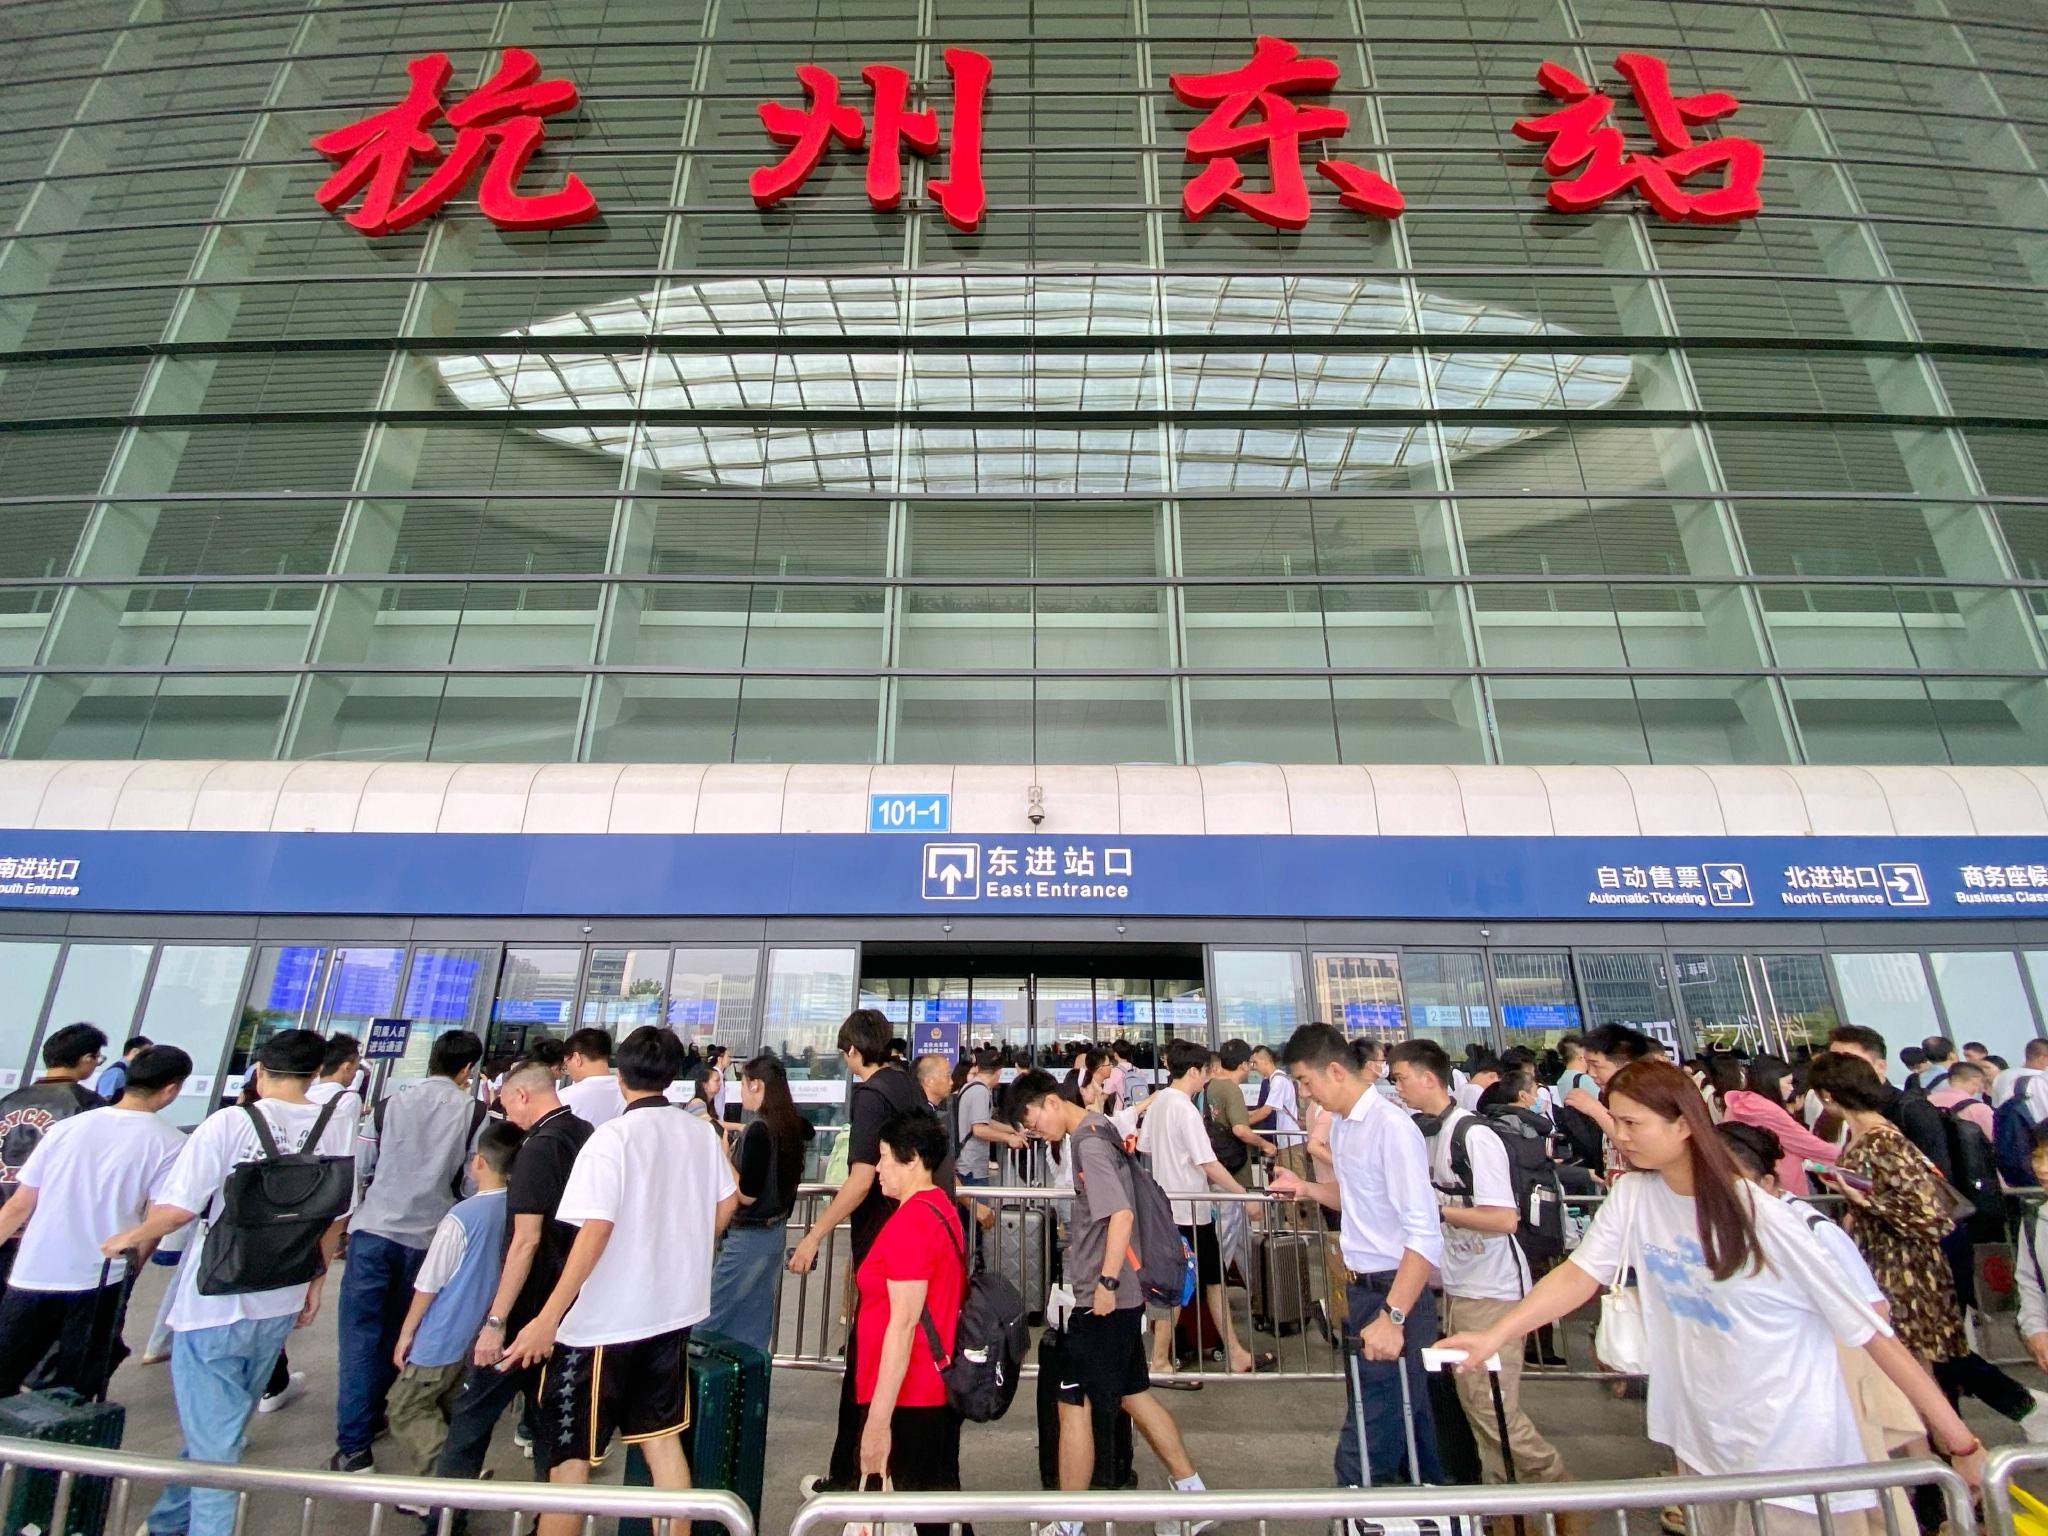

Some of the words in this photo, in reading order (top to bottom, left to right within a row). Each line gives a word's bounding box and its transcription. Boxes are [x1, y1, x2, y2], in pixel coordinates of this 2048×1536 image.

[310, 36, 1765, 236] 杭州东站
[879, 800, 940, 826] 101-1
[0, 857, 81, 880] 南进站口
[987, 846, 1133, 877] 东进站口
[1597, 865, 1702, 889] 自动售票
[1784, 865, 1880, 889] 北进站口
[1960, 864, 2048, 888] 商务座候
[24, 882, 80, 896] Entrance
[986, 881, 1032, 897] East
[1036, 881, 1129, 898] Entrance
[1588, 892, 1650, 905] Automatic
[1651, 891, 1707, 906] Ticketing
[1781, 892, 1822, 904] North
[1823, 892, 1885, 904] Entrance
[1955, 891, 2015, 904] Business
